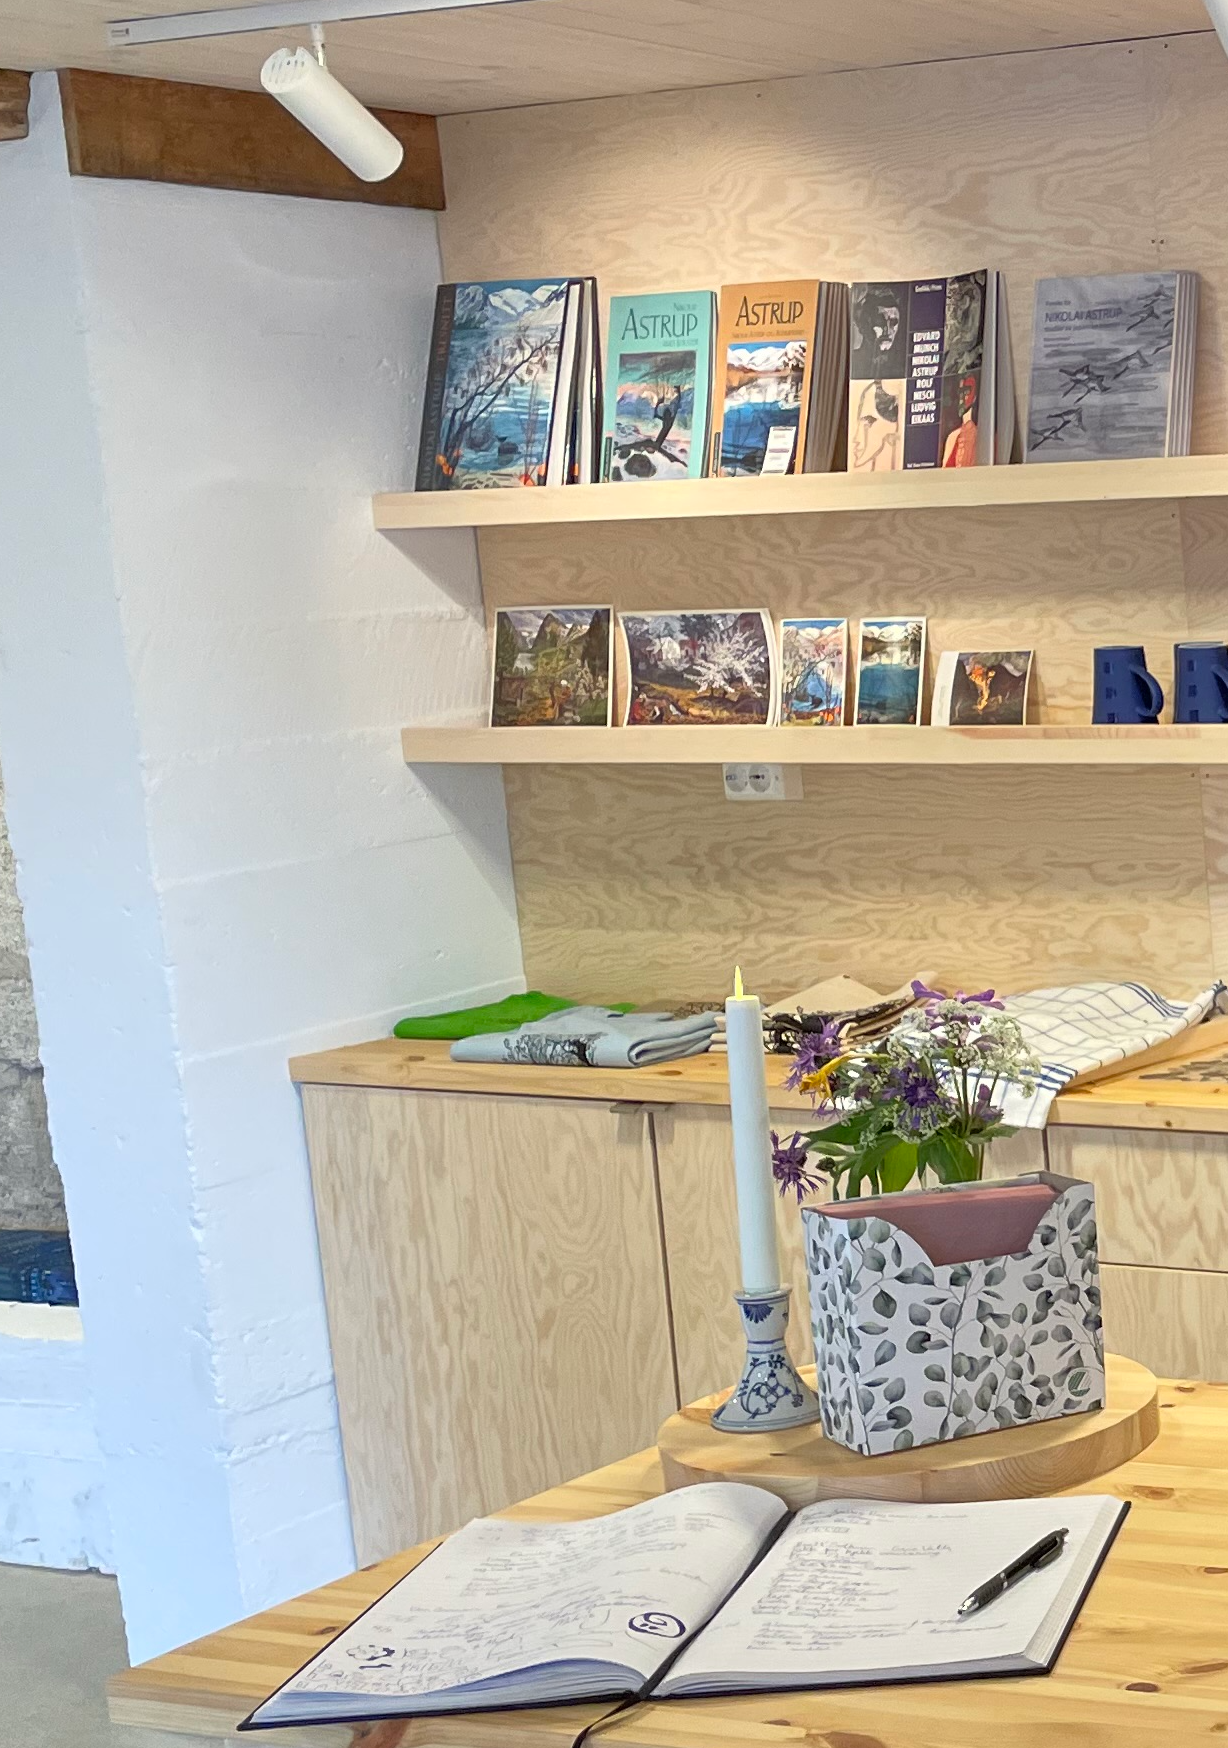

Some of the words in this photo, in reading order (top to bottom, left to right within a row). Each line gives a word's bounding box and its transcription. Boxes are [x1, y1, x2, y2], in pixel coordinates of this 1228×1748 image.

[735, 295, 803, 326] ASTRUP
[1045, 311, 1083, 322] NIKOLAI
[1085, 307, 1123, 320] ASTRUP
[621, 308, 698, 340] ASTRUP
[912, 366, 938, 377] ASTRUP
